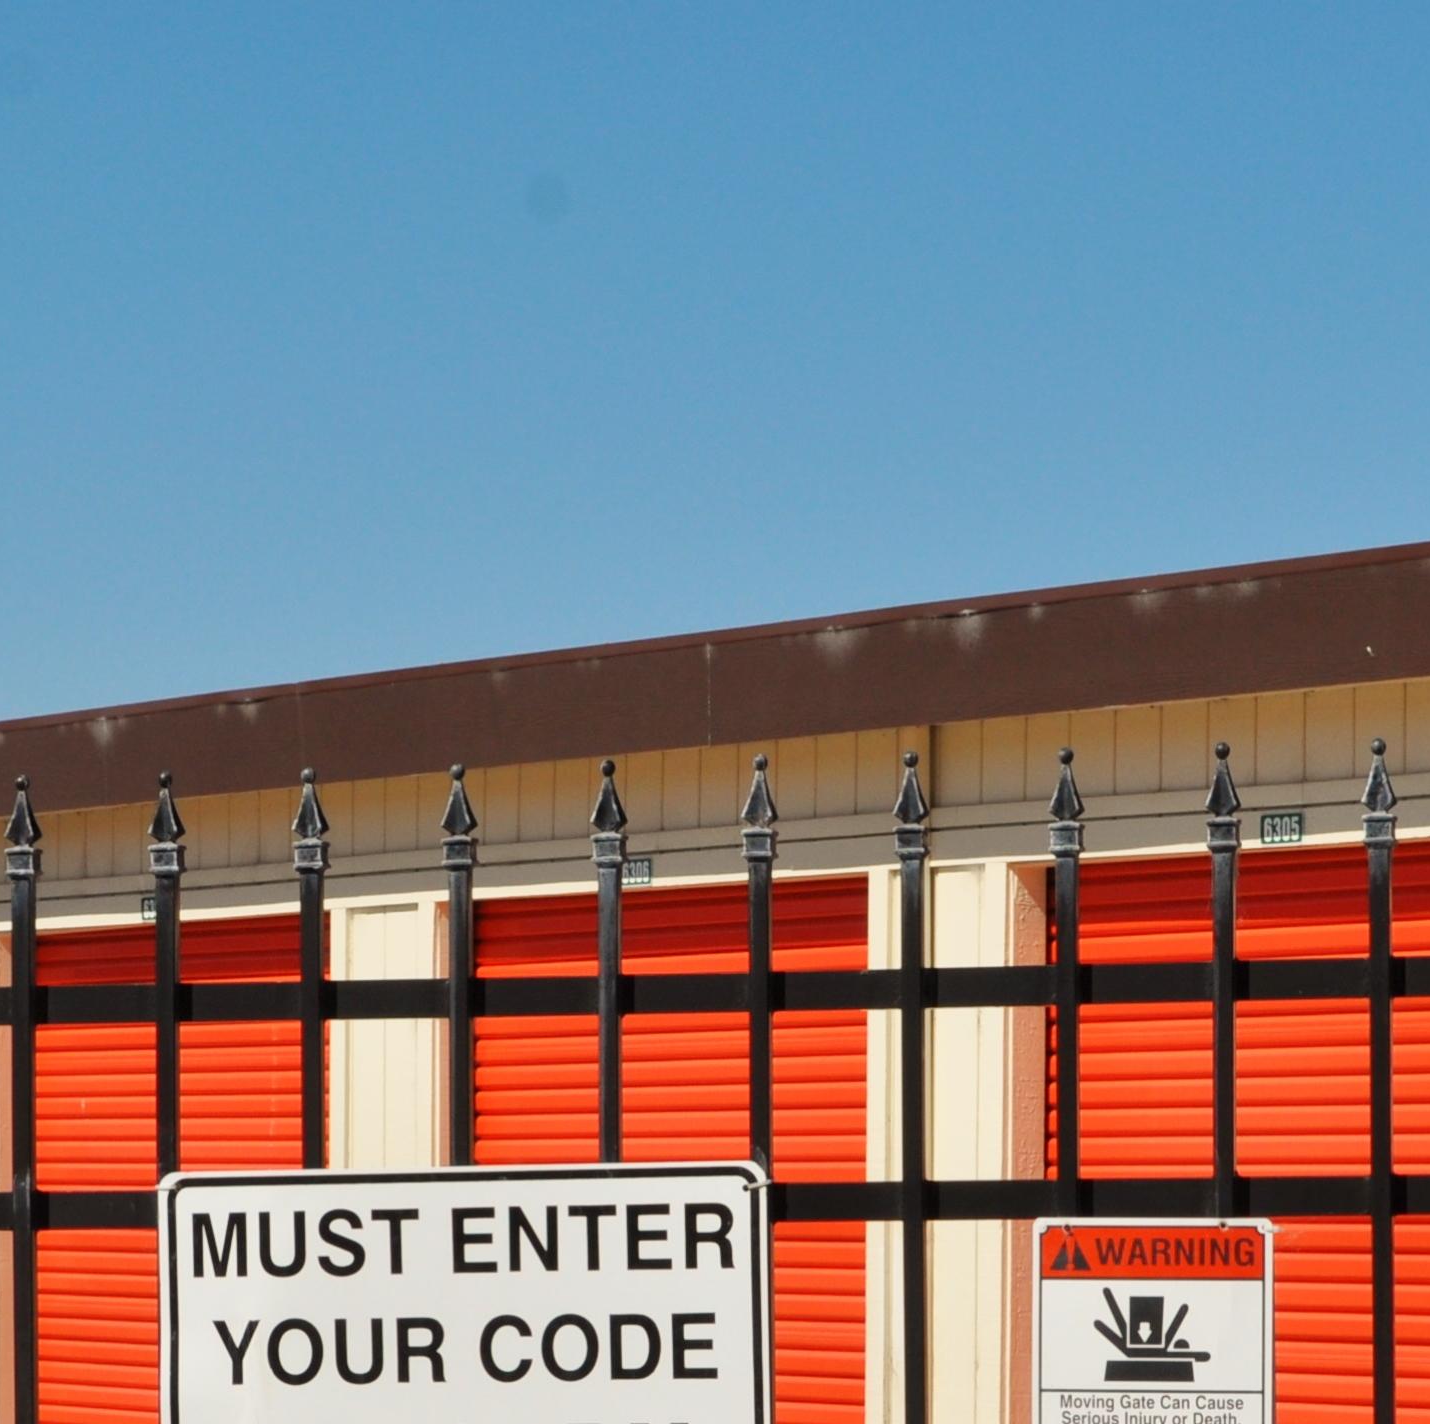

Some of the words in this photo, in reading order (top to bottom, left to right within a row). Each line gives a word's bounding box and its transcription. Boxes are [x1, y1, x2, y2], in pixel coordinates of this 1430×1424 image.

[1263, 816, 1299, 842] 6305
[192, 1209, 419, 1277] MUST
[452, 1203, 734, 1273] ENTER
[1096, 1238, 1255, 1266] WARNING
[213, 1317, 445, 1385] YOUR
[480, 1313, 718, 1382] CODE
[1060, 1395, 1114, 1412] Moving
[1120, 1395, 1155, 1409] Gate
[1160, 1395, 1190, 1409] Can
[1195, 1396, 1244, 1410] Cause
